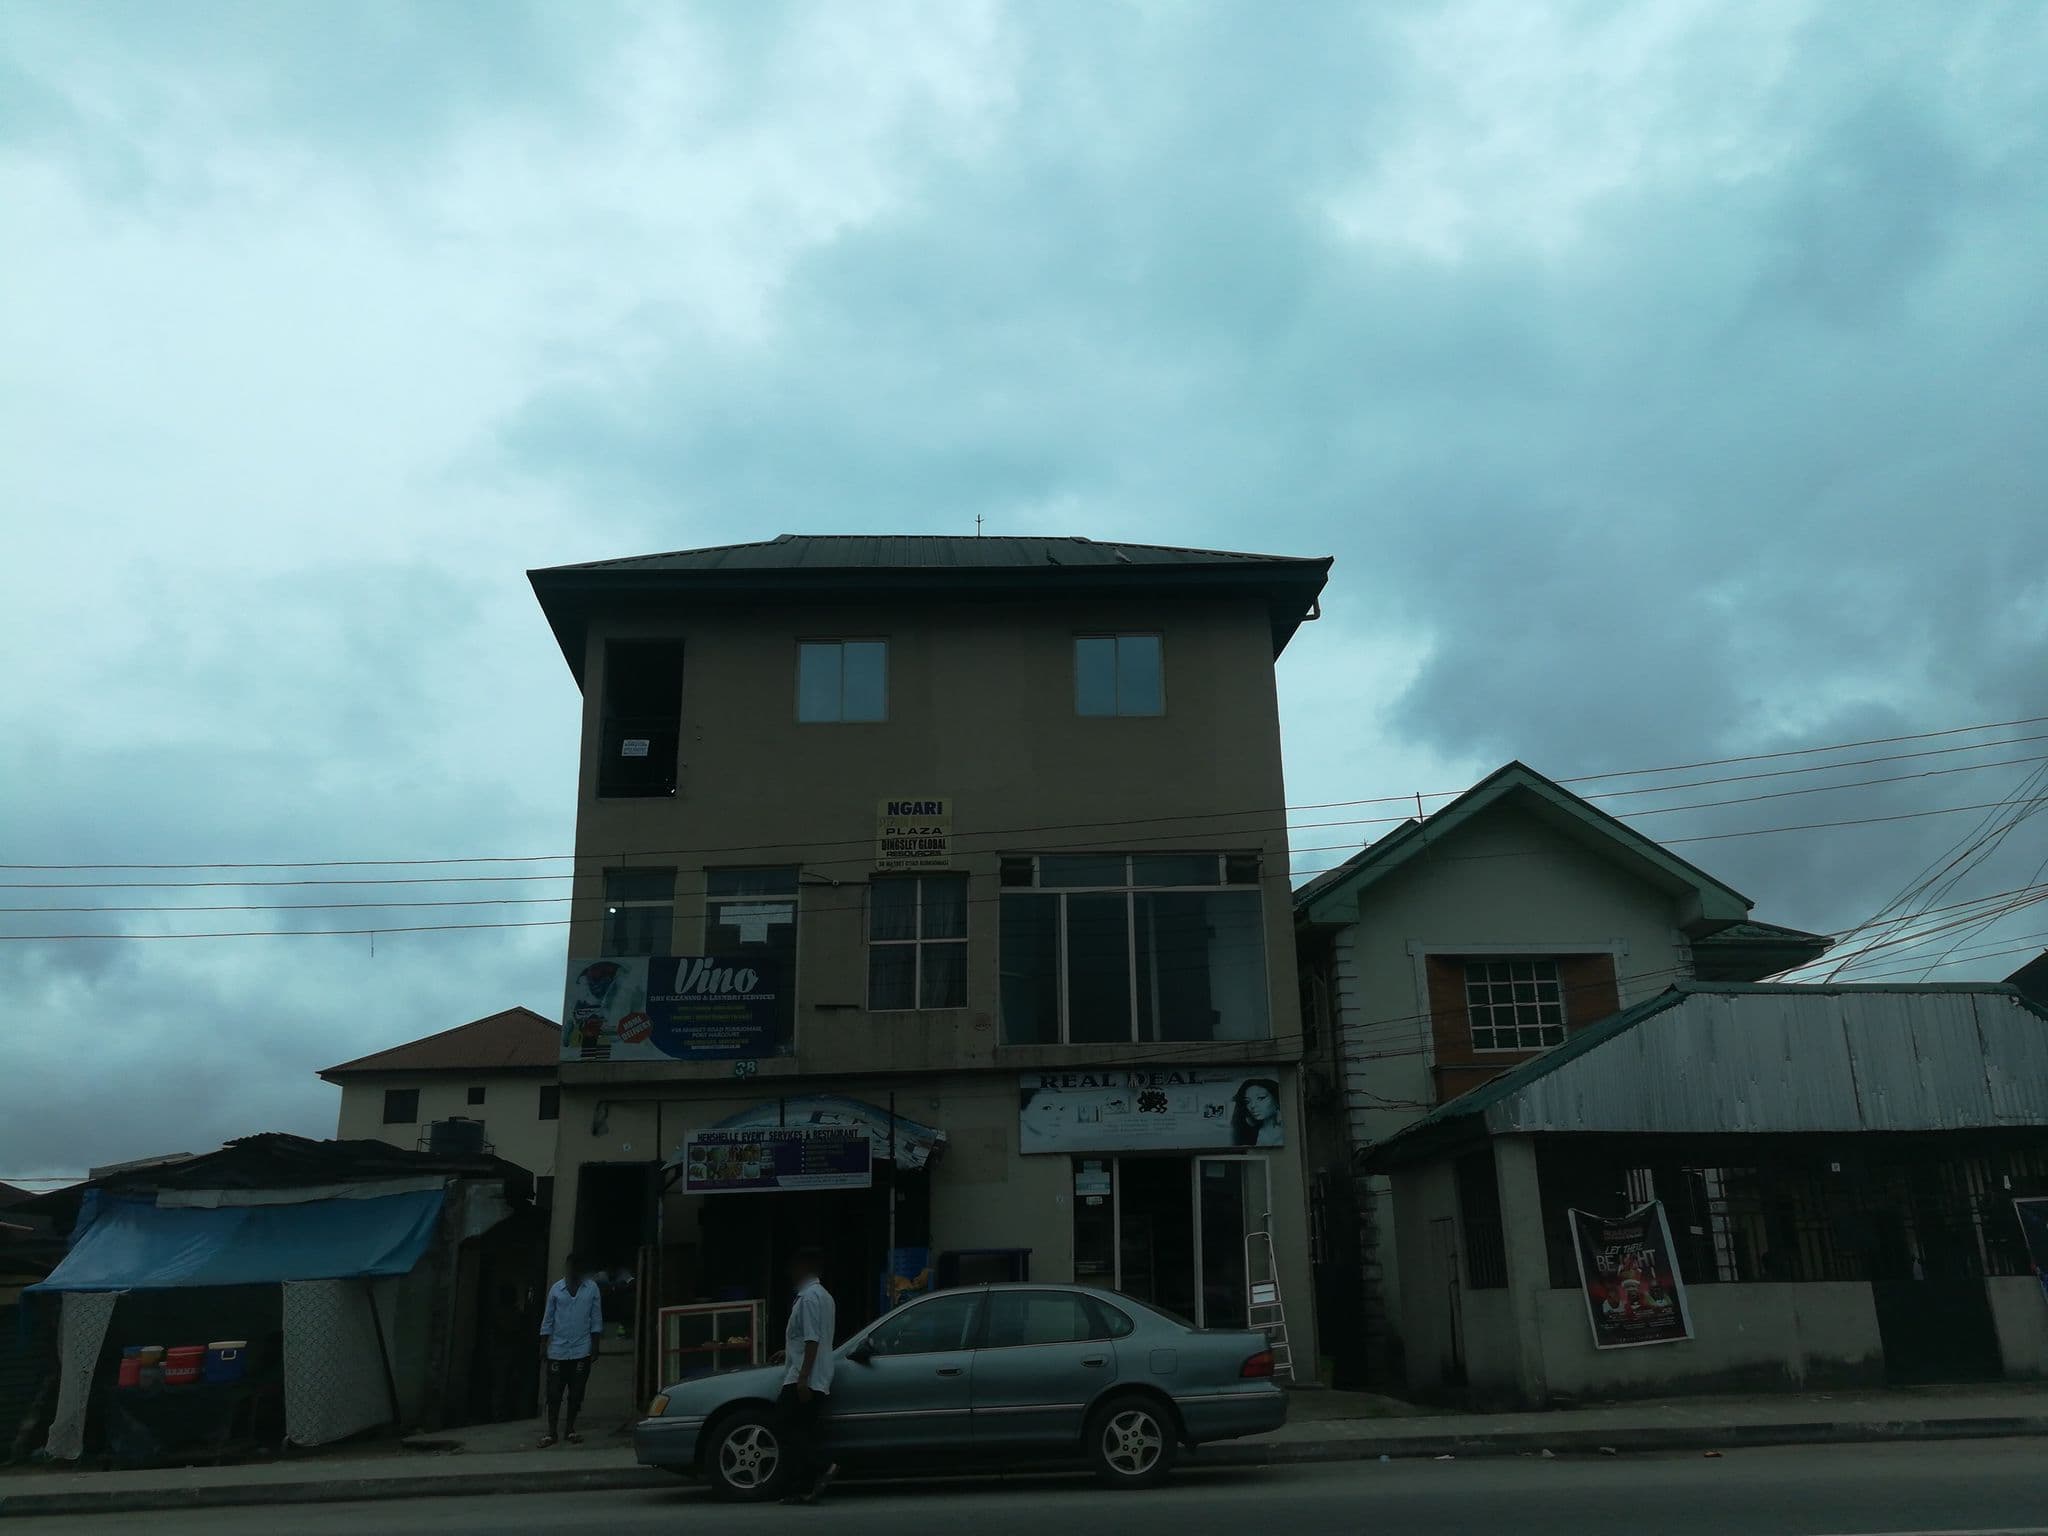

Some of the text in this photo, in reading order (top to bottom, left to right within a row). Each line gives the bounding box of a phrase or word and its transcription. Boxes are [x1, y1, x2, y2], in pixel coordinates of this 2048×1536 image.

[888, 801, 943, 815] NGARI
[886, 827, 943, 835] PLAZA
[918, 838, 946, 850] GLOBAL
[674, 957, 759, 994] Vino
[743, 993, 774, 1001] SERVICES
[736, 1061, 756, 1075] 38
[1040, 1074, 1116, 1088] REAL
[1128, 1071, 1203, 1087] DEAL
[1605, 1245, 1622, 1254] LET
[1595, 1255, 1617, 1273] BE
